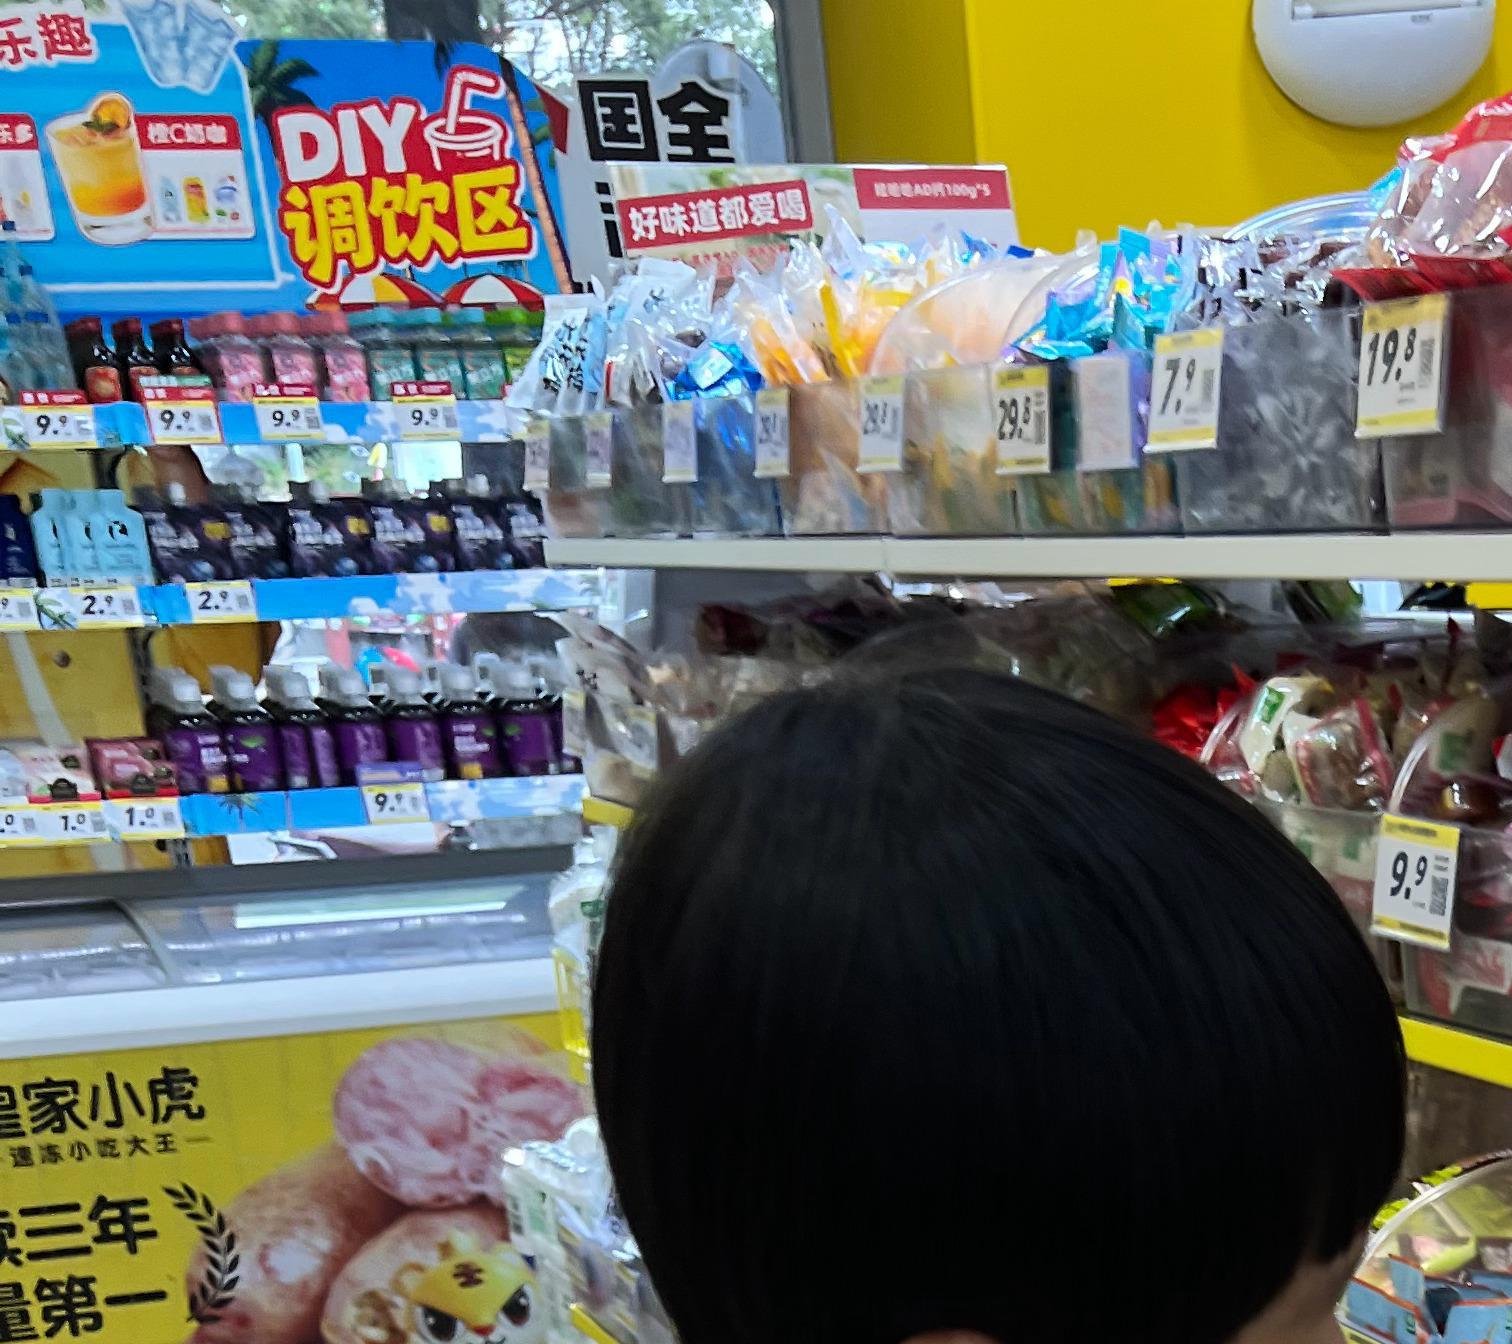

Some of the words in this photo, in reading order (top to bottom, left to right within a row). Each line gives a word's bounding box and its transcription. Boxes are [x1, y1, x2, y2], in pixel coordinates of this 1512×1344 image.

[277, 103, 417, 183] DIY
[285, 167, 530, 284] 调饮区
[628, 188, 807, 241] 好味道都爱喝
[1366, 328, 1417, 386] 19.8
[1158, 358, 1196, 415] 7.9
[36, 412, 63, 435] 9.9
[160, 409, 191, 432] 9.9
[272, 409, 300, 428] 9.9
[411, 407, 439, 428] 9.9
[83, 592, 114, 615] 2.9
[199, 589, 229, 611] 2.9
[375, 791, 404, 811] 9.9
[60, 813, 86, 832] 1.0
[125, 804, 155, 826] 1.0
[1390, 852, 1428, 899] 9.9
